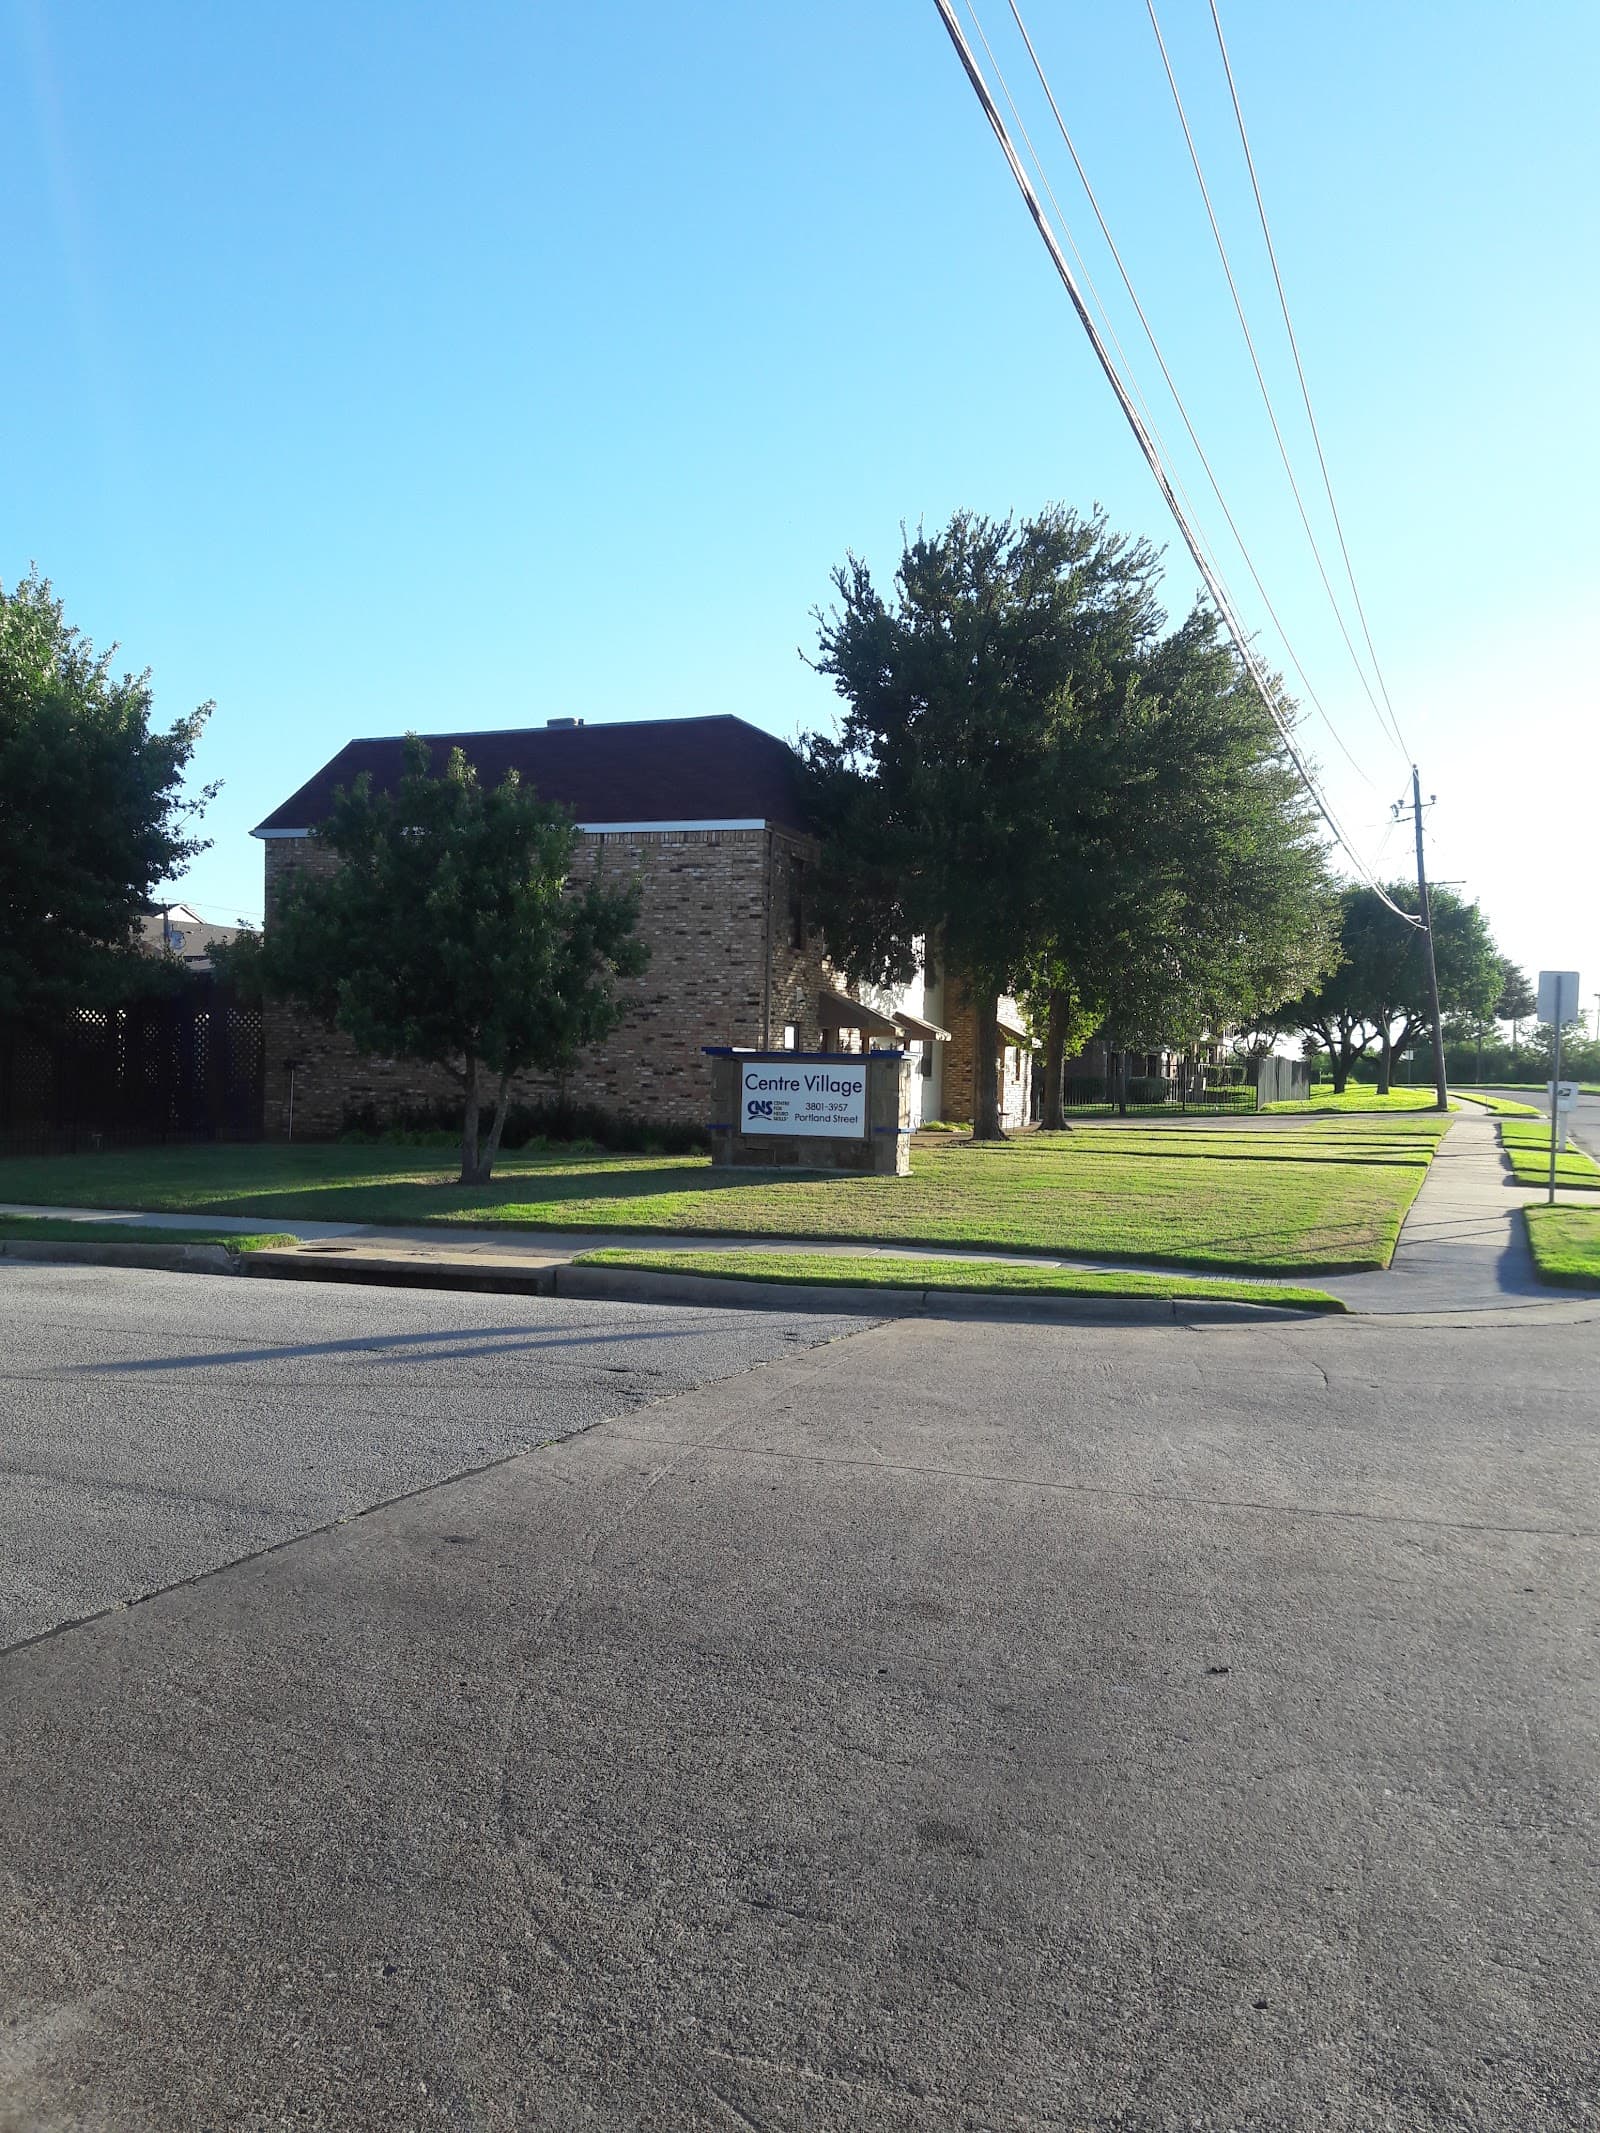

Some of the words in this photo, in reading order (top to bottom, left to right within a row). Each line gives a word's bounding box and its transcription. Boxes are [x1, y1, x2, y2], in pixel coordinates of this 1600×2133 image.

[745, 1073, 800, 1091] Centre
[804, 1074, 863, 1097] Village
[747, 1100, 773, 1115] CNS
[805, 1103, 848, 1112] 3801-3957
[794, 1113, 831, 1123] Portland
[833, 1114, 858, 1124] Street
